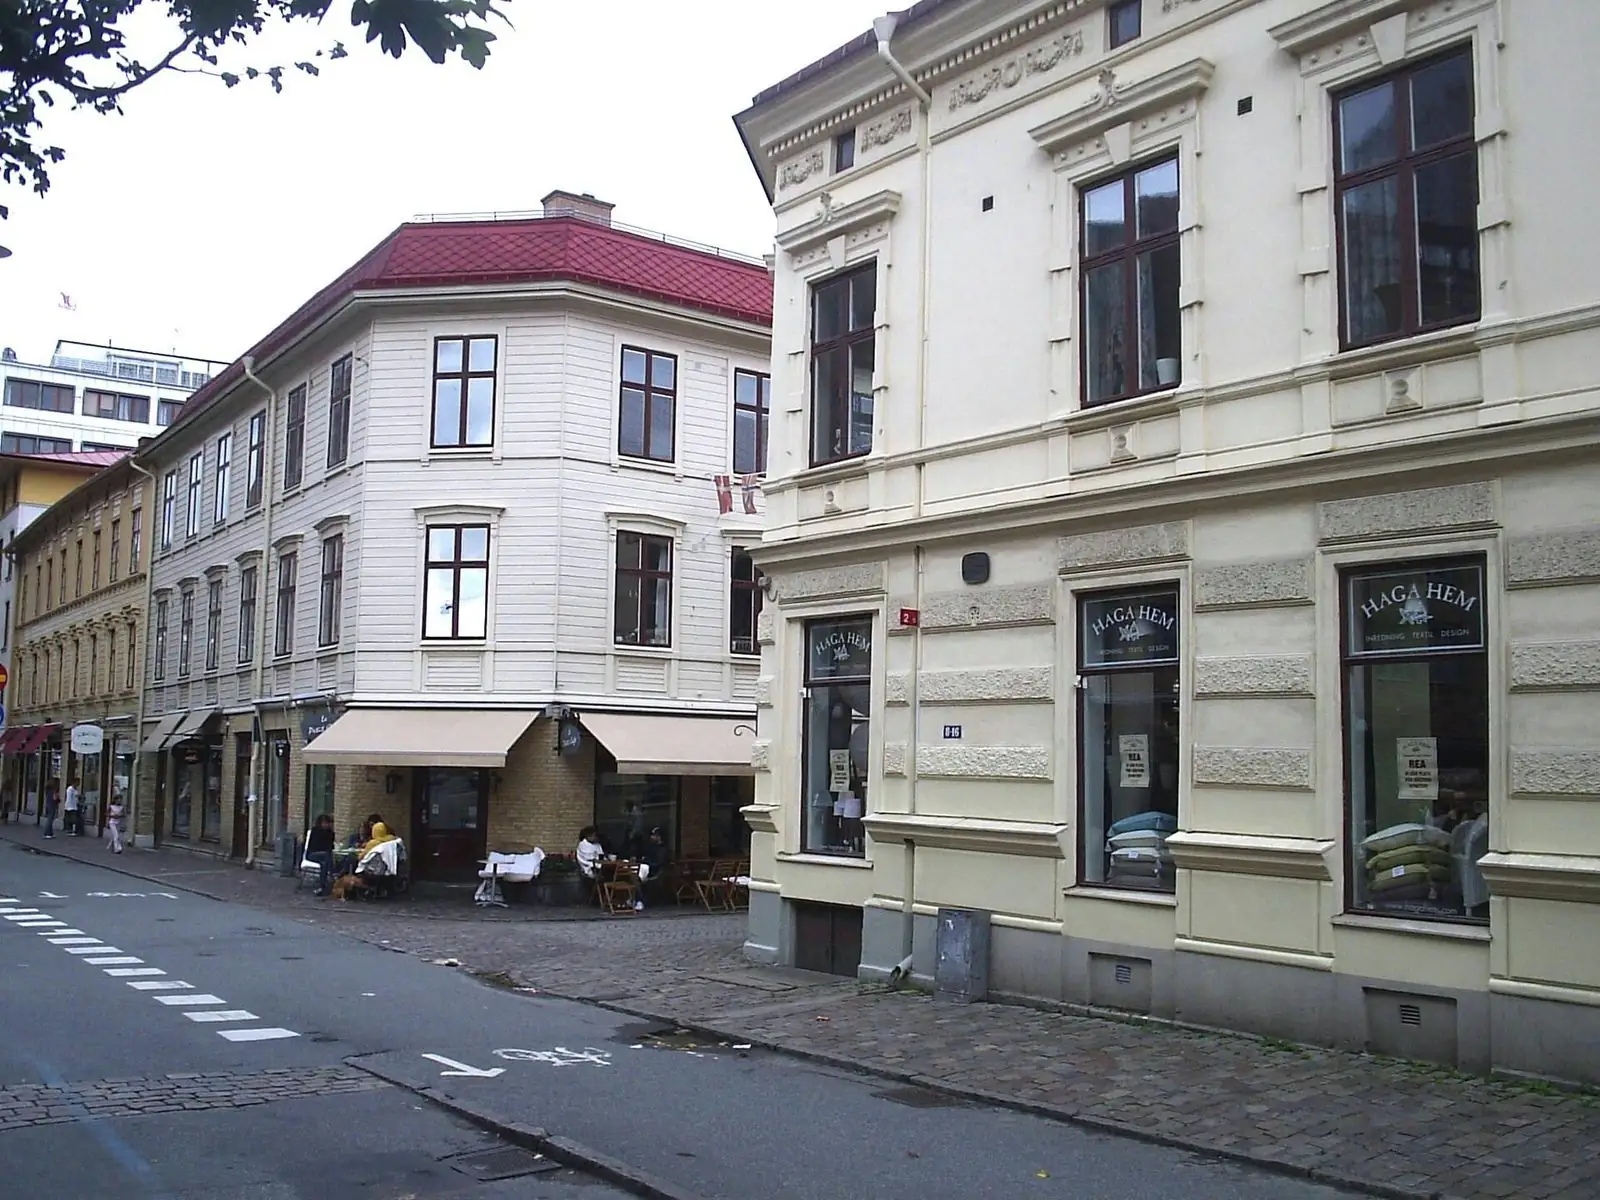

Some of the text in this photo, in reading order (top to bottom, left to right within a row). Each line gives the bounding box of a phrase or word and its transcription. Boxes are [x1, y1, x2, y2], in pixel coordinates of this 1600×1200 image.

[1361, 582, 1477, 619] HAGA HEM
[1092, 605, 1175, 636] HAGA HEM
[815, 632, 871, 656] HAGA HEM
[1441, 628, 1470, 638] DESIGN
[1408, 759, 1427, 769] REA
